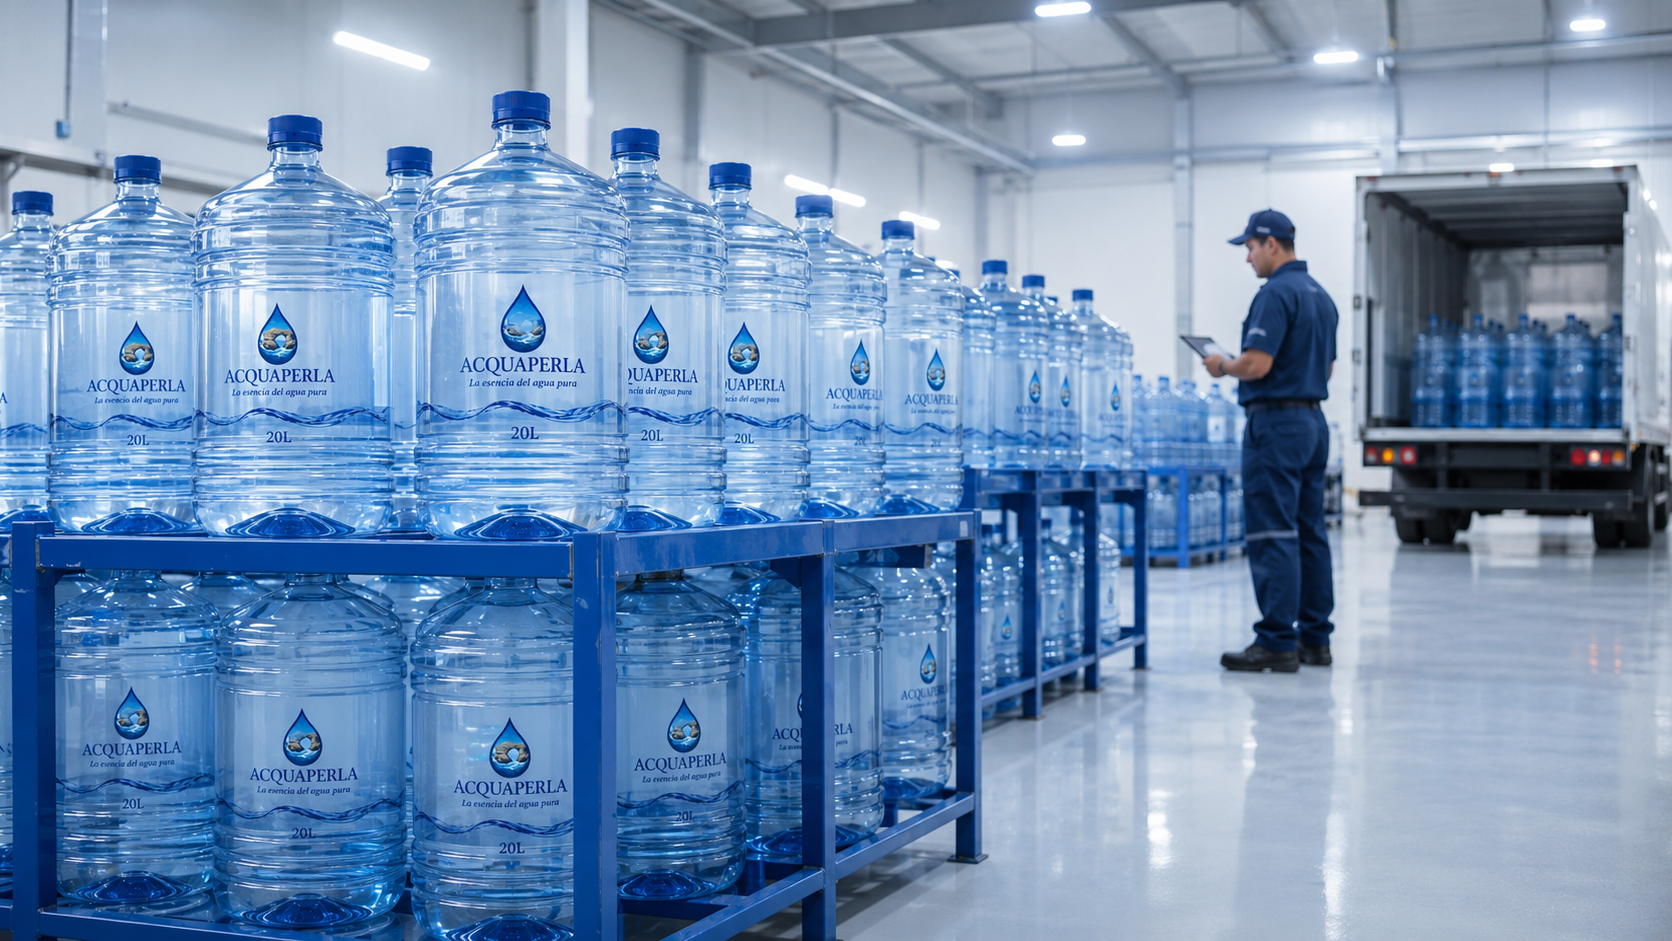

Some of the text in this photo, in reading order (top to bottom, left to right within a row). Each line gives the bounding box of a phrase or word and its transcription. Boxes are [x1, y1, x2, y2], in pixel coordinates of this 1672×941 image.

[460, 356, 586, 376] ACQUAPERLA
[224, 369, 336, 386] ACQUAPERLA
[469, 378, 577, 389] La esencia del agua pura
[87, 379, 186, 395] ACQUAPERLA
[645, 387, 657, 395] del
[725, 378, 786, 394] UAPERLA
[232, 388, 241, 396] La
[271, 388, 284, 396] del
[286, 389, 306, 398] agua
[308, 390, 327, 398] pura
[131, 396, 142, 404] del
[266, 431, 292, 443] 20L
[511, 426, 539, 440] 20L
[641, 430, 664, 442] 20L
[734, 433, 754, 444] 20L
[127, 434, 149, 446] 20L
[82, 741, 182, 759] ACQUAPERLA
[127, 759, 137, 767] del
[633, 752, 727, 773] ACQUAPERLA
[250, 767, 358, 785] ACQUAPERLA
[642, 775, 651, 783] La
[680, 773, 691, 781] del
[257, 786, 351, 797] La esencia del agua pura
[454, 779, 568, 799] ACQUAPERLA
[122, 799, 144, 810] 20L
[461, 799, 472, 807] La
[473, 800, 503, 809] esencia
[504, 799, 517, 808] del
[519, 801, 539, 809] agua
[291, 828, 316, 839] 20L
[499, 842, 525, 854] 20L
